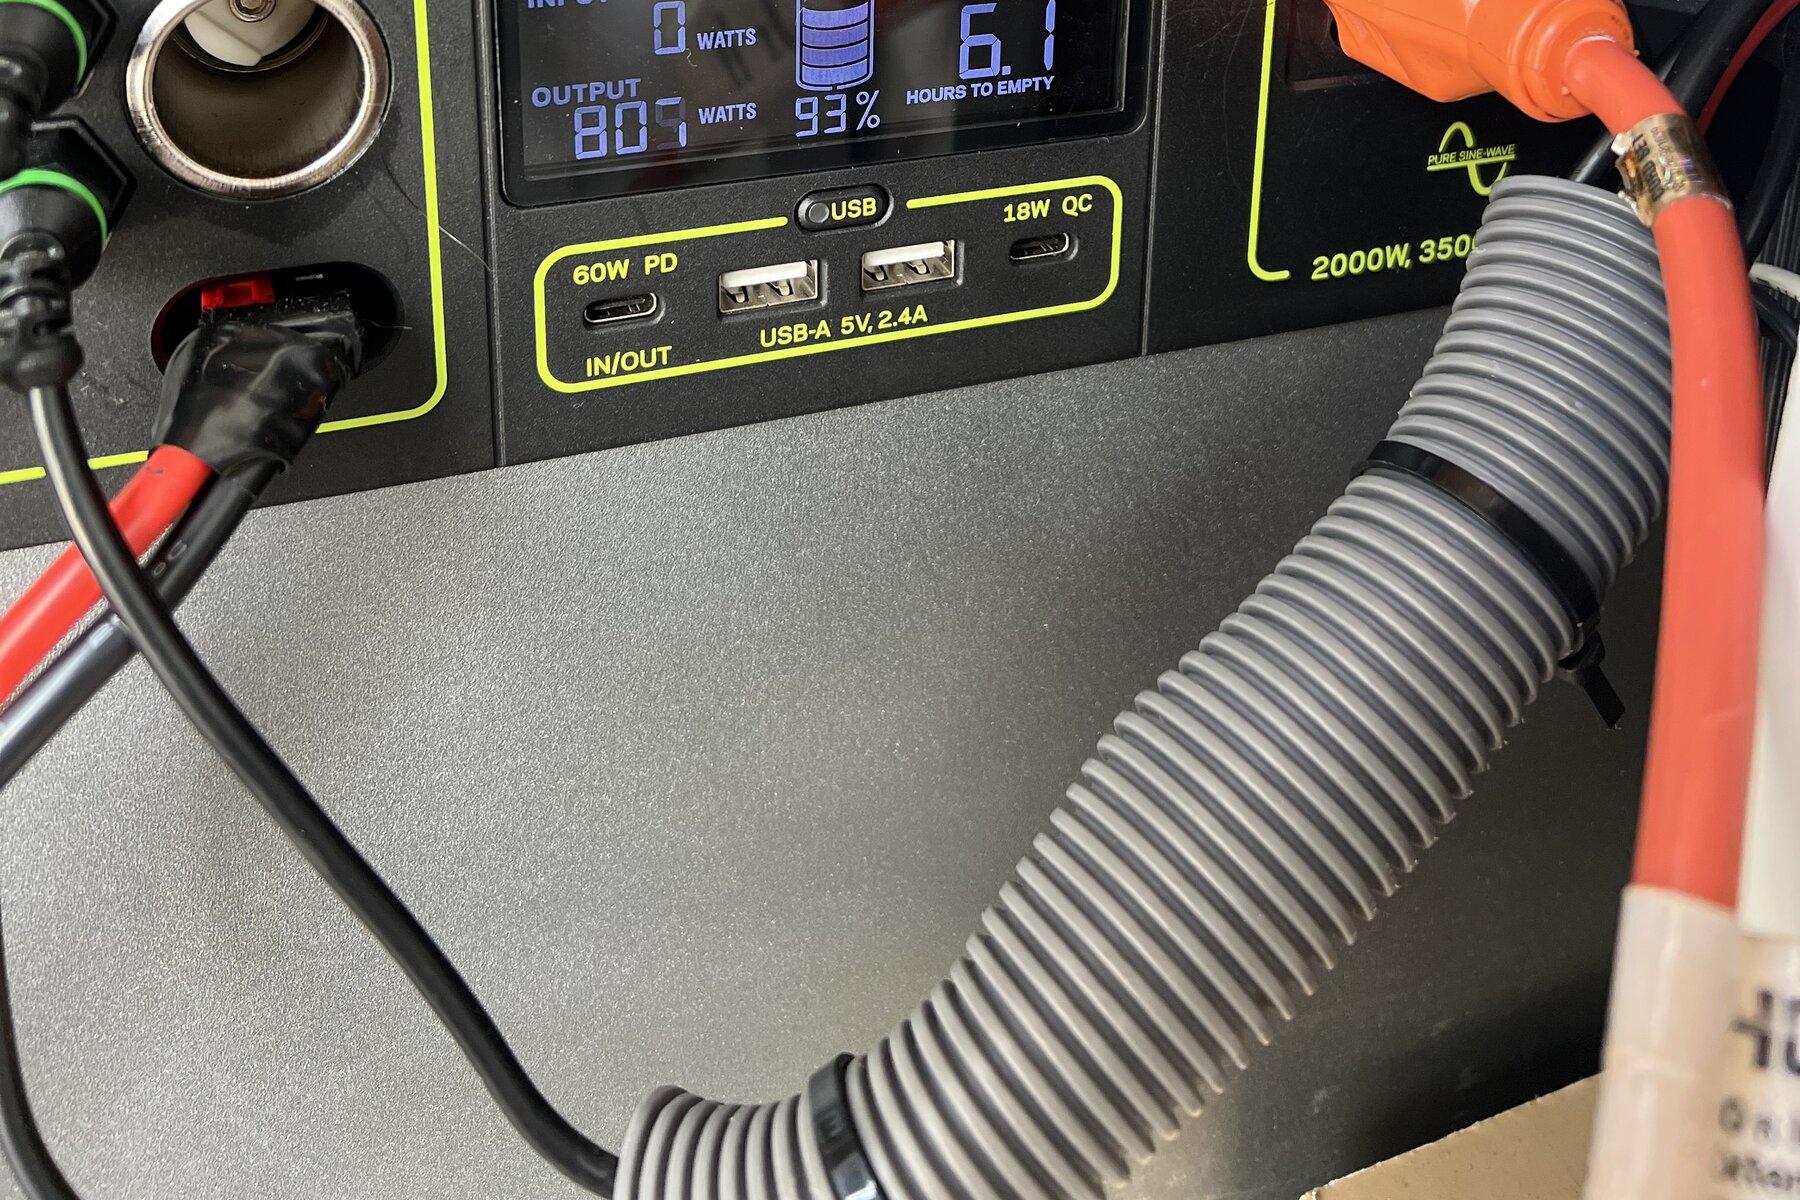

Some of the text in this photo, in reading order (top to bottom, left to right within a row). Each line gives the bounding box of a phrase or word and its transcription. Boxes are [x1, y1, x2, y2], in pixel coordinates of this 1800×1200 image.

[652, 0, 757, 56] 0 WATTS
[531, 78, 641, 108] OUTPUT
[906, 74, 1055, 105] HOURS TO EMPTY
[699, 103, 757, 124] WATTS
[1427, 143, 1516, 166] PURE SINE-WAVE
[832, 198, 877, 221] USB
[1003, 193, 1093, 223] 18W QC
[1419, 233, 1476, 263] 350
[572, 252, 678, 286] 60W PD
[759, 320, 831, 348] USB-A
[585, 346, 673, 378] IN/OUT
